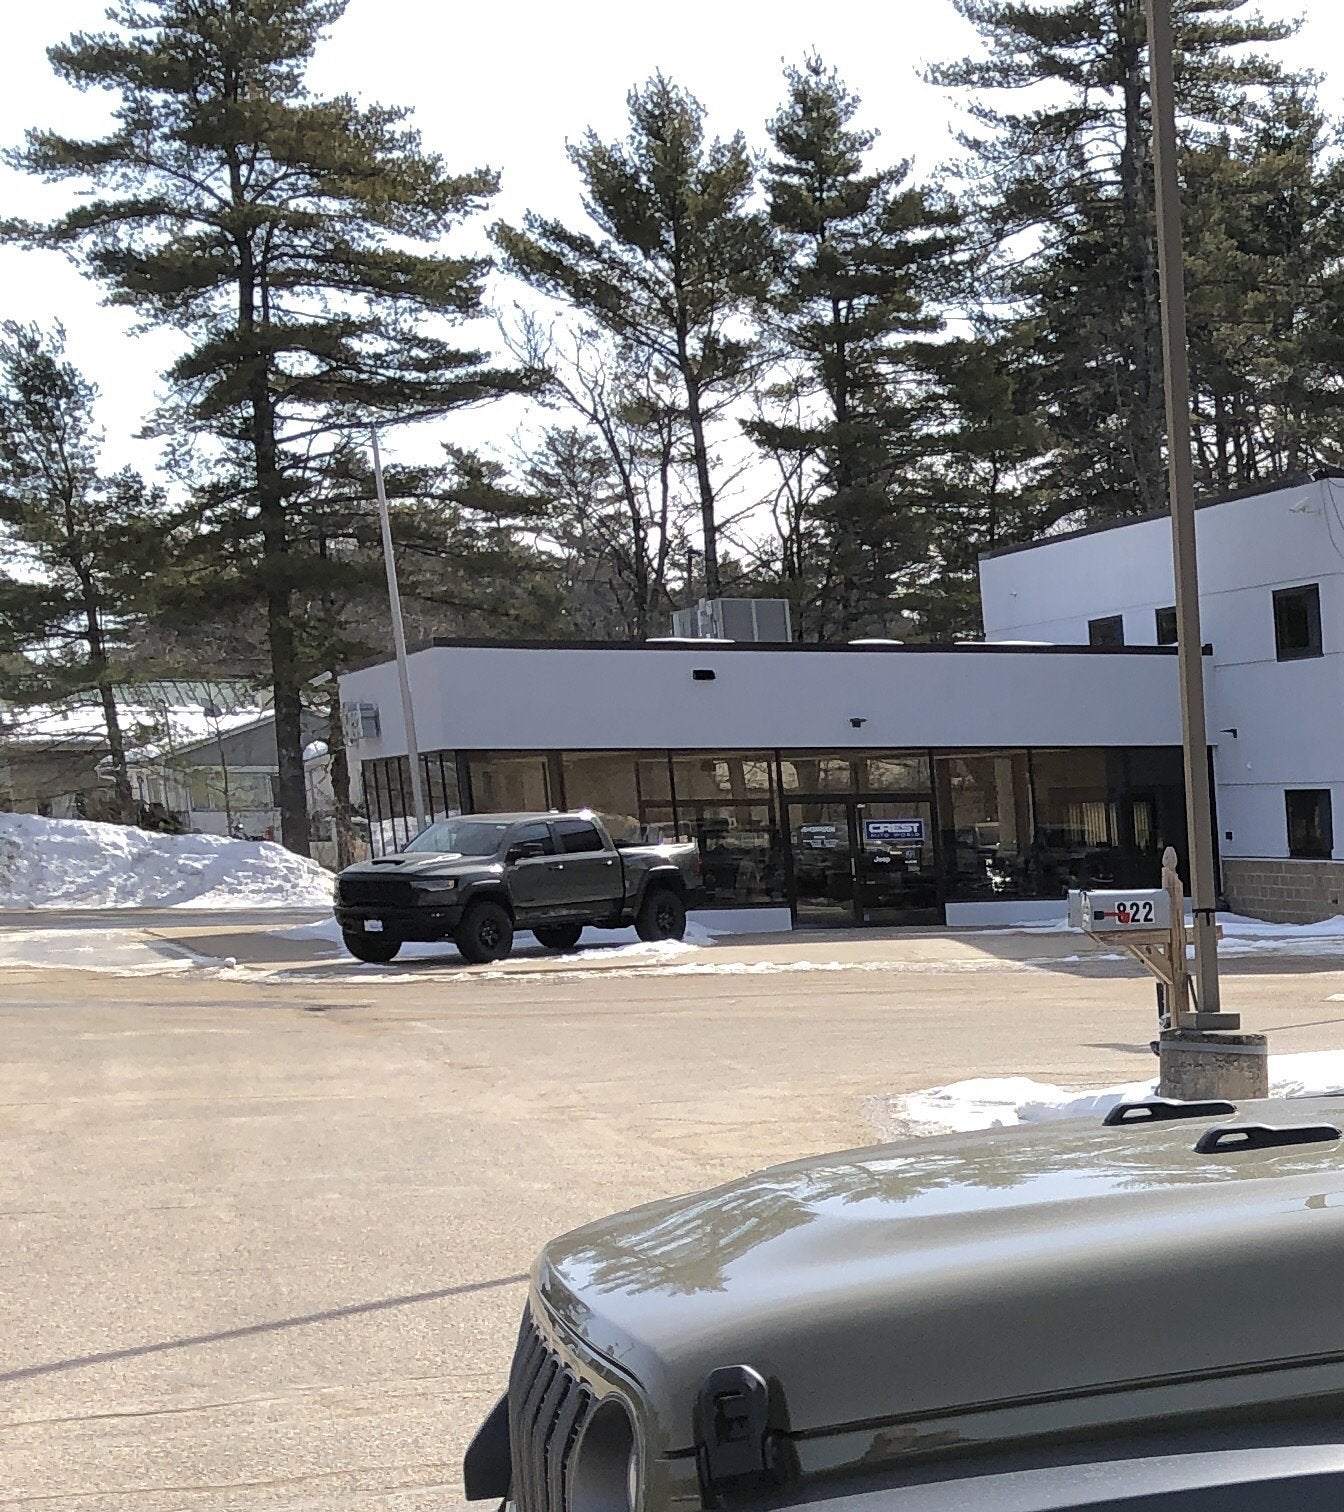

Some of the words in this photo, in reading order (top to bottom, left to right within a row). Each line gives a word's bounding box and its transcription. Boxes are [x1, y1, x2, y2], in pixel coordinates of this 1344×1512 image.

[869, 823, 920, 833] CREST
[873, 856, 891, 864] Jeep
[1116, 901, 1154, 923] 822
